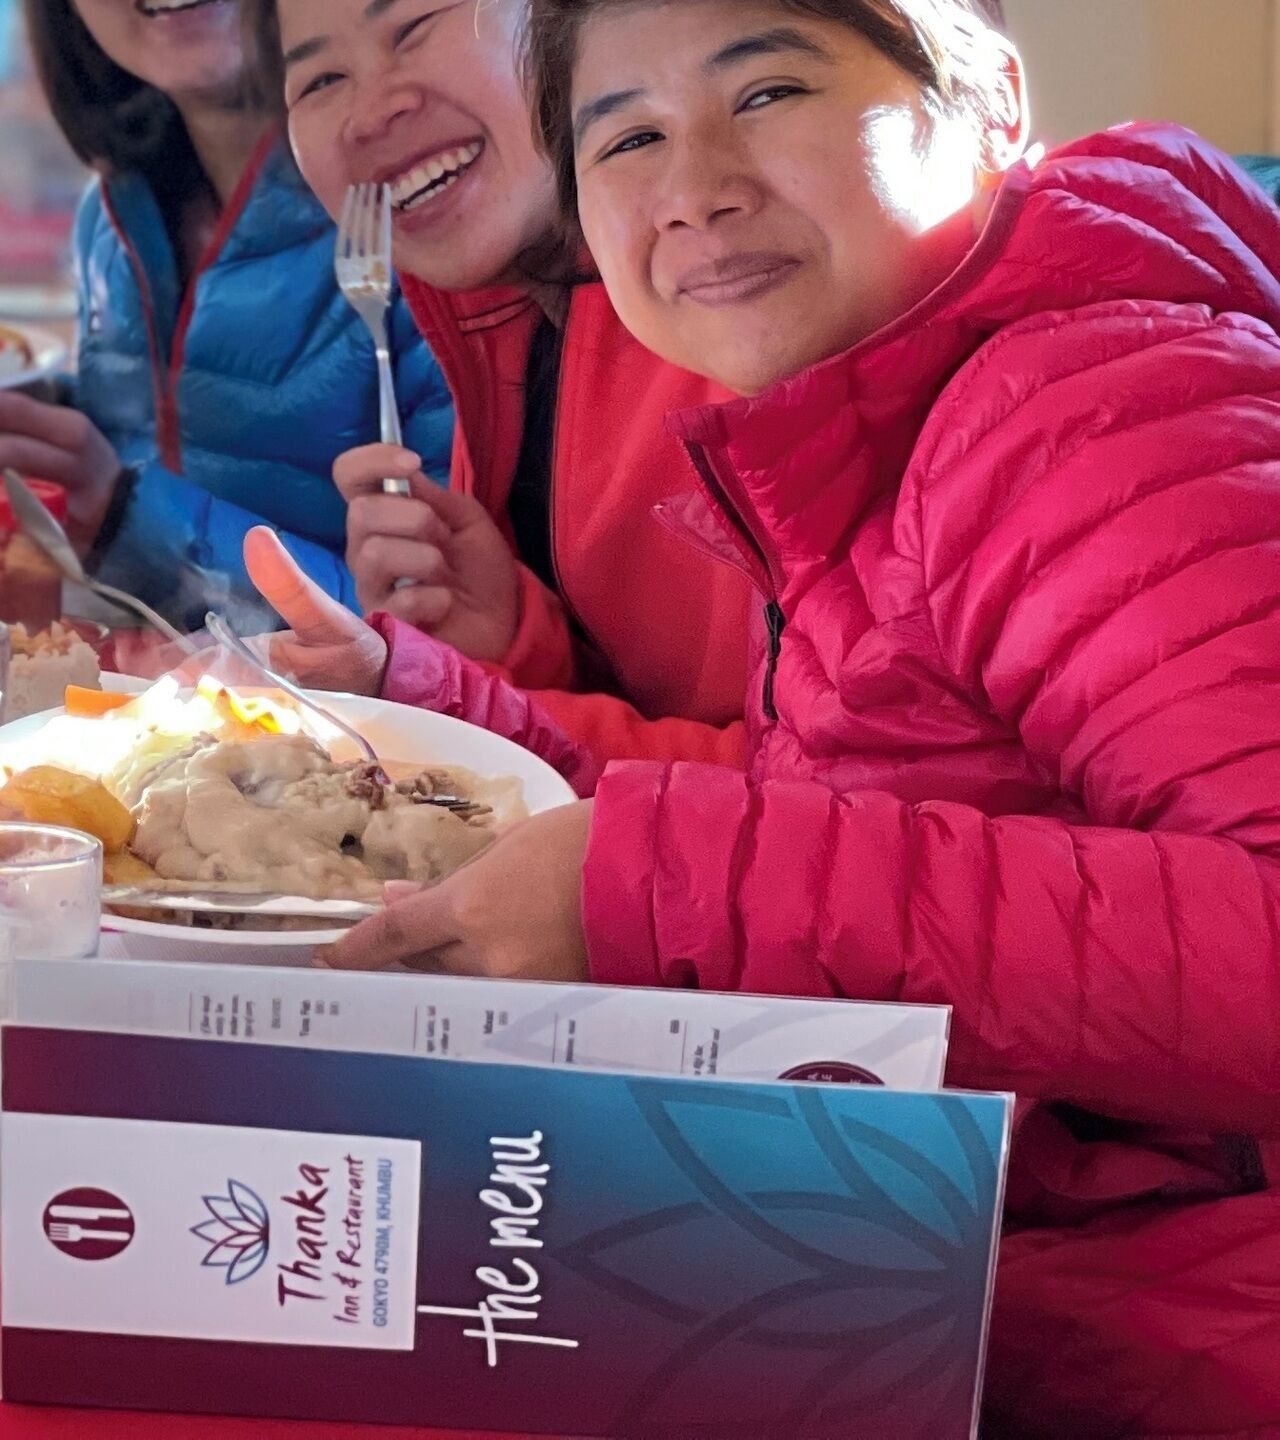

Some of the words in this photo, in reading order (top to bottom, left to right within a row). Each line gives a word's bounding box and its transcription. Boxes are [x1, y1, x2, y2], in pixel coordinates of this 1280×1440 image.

[277, 1161, 330, 1306] Thanka
[336, 1153, 364, 1267] Restaurant
[376, 1159, 393, 1221] KHUMBU
[479, 1130, 551, 1248] menu
[333, 1294, 359, 1324] Inn
[373, 1286, 388, 1327] GOKYO
[417, 1258, 578, 1367] the
